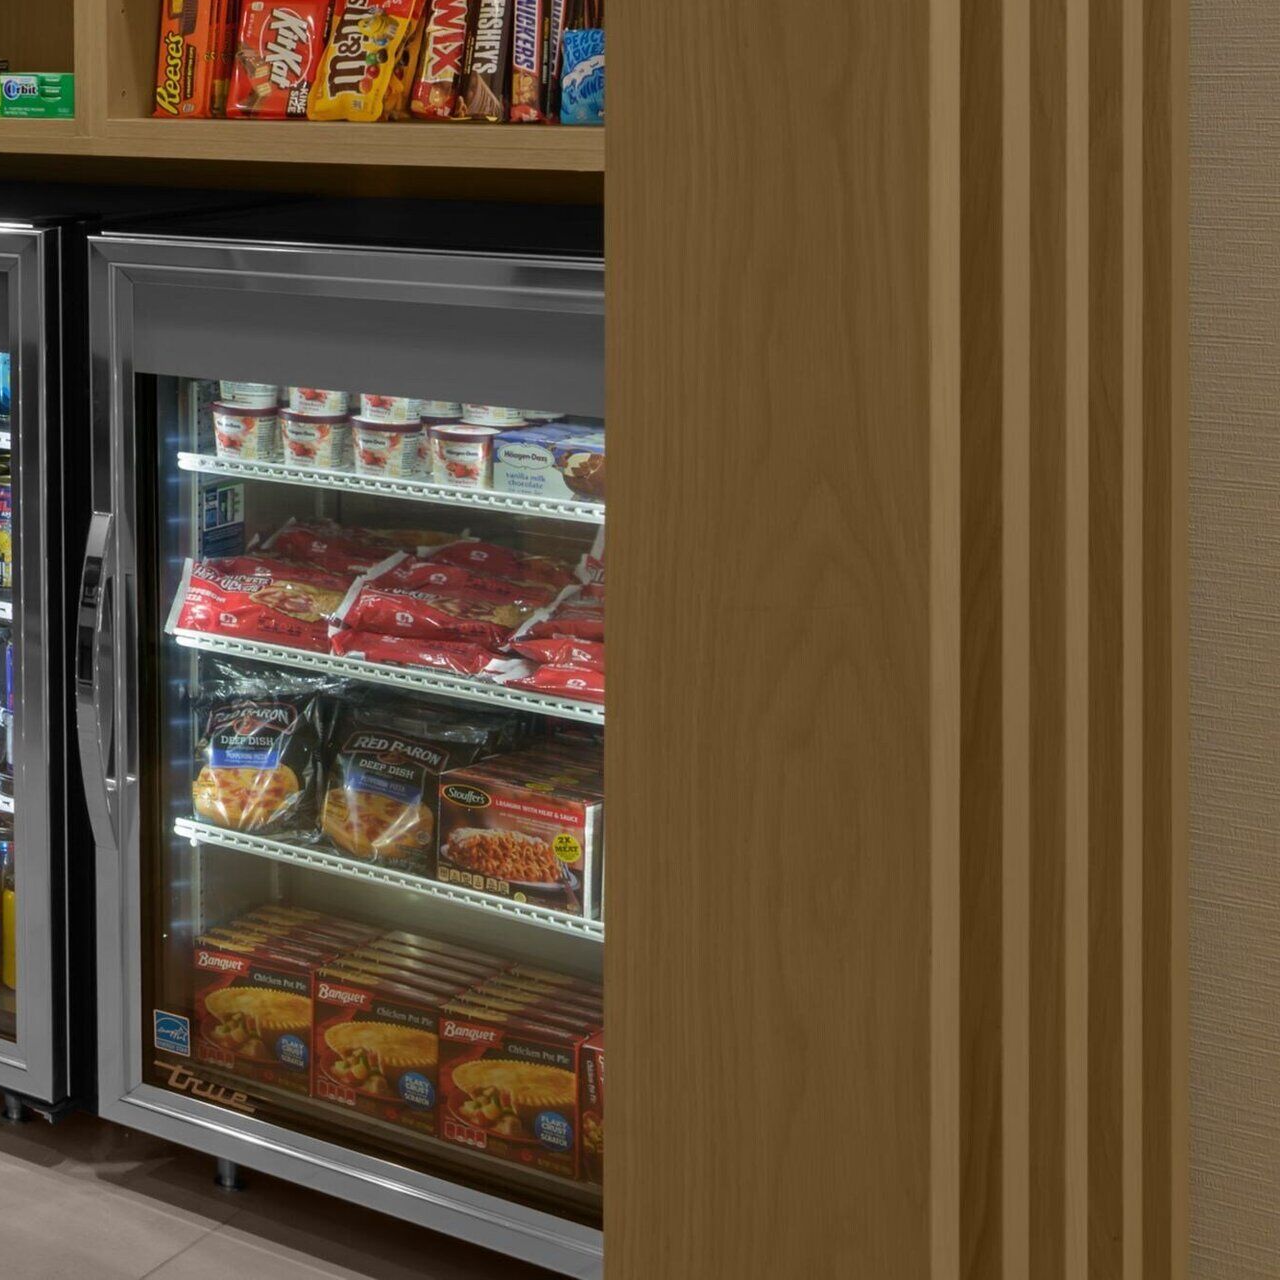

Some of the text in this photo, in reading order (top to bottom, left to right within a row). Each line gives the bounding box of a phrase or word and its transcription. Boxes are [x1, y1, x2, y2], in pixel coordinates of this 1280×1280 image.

[157, 32, 183, 115] Reese's
[4, 80, 37, 100] Orbit
[221, 735, 274, 746] DEEP DISH
[353, 735, 442, 766] RED BARON
[359, 758, 415, 780] DEEP DISH
[448, 788, 485, 807] Stouffer's
[198, 951, 244, 970] Banquet
[253, 973, 306, 990] Chicken Pot Pie
[318, 983, 368, 1004] Banquet
[376, 1007, 434, 1026] Chicken Pot Pie
[444, 1021, 497, 1041] Banquet
[508, 1044, 570, 1064] Chicken Pot Pie
